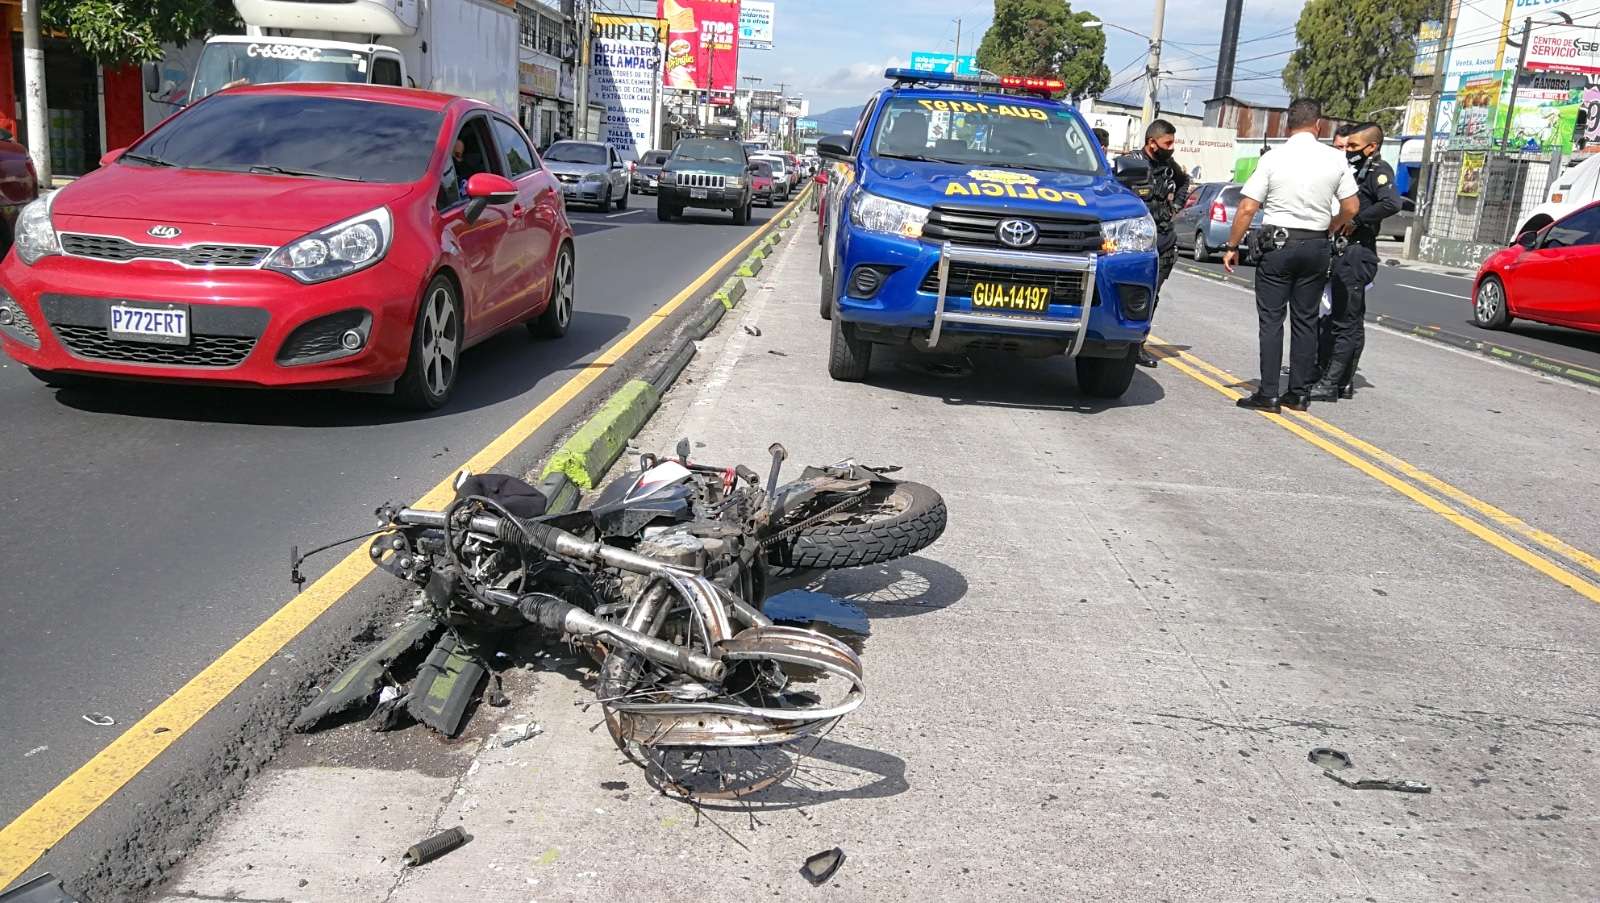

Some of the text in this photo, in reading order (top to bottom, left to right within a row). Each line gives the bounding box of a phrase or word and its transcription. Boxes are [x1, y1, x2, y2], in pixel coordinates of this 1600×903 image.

[1533, 36, 1573, 47] CENTRO DE
[1531, 45, 1577, 58] SERVICIO
[151, 225, 175, 235] KIA
[973, 282, 1048, 310] GUA-14197
[112, 309, 184, 333] P772FRT
